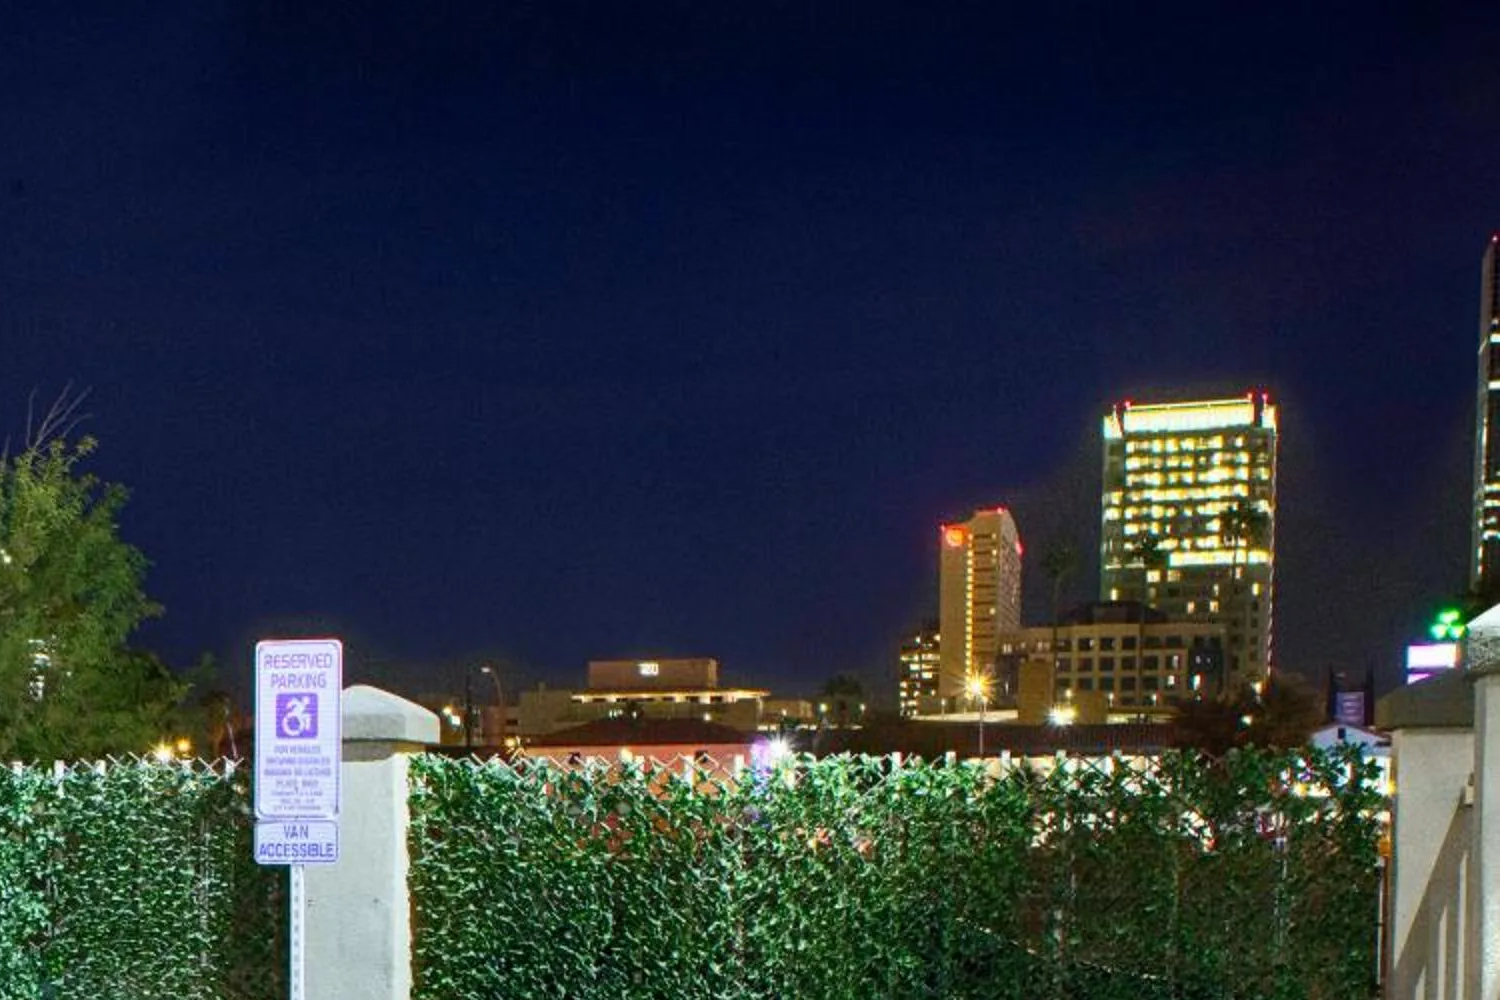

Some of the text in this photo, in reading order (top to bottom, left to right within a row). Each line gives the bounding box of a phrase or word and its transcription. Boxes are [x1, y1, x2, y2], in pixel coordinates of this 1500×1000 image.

[263, 653, 332, 669] RESERVED
[271, 672, 326, 688] PARKING
[283, 825, 309, 839] VAN
[260, 843, 335, 857] ACCESSIBLE
